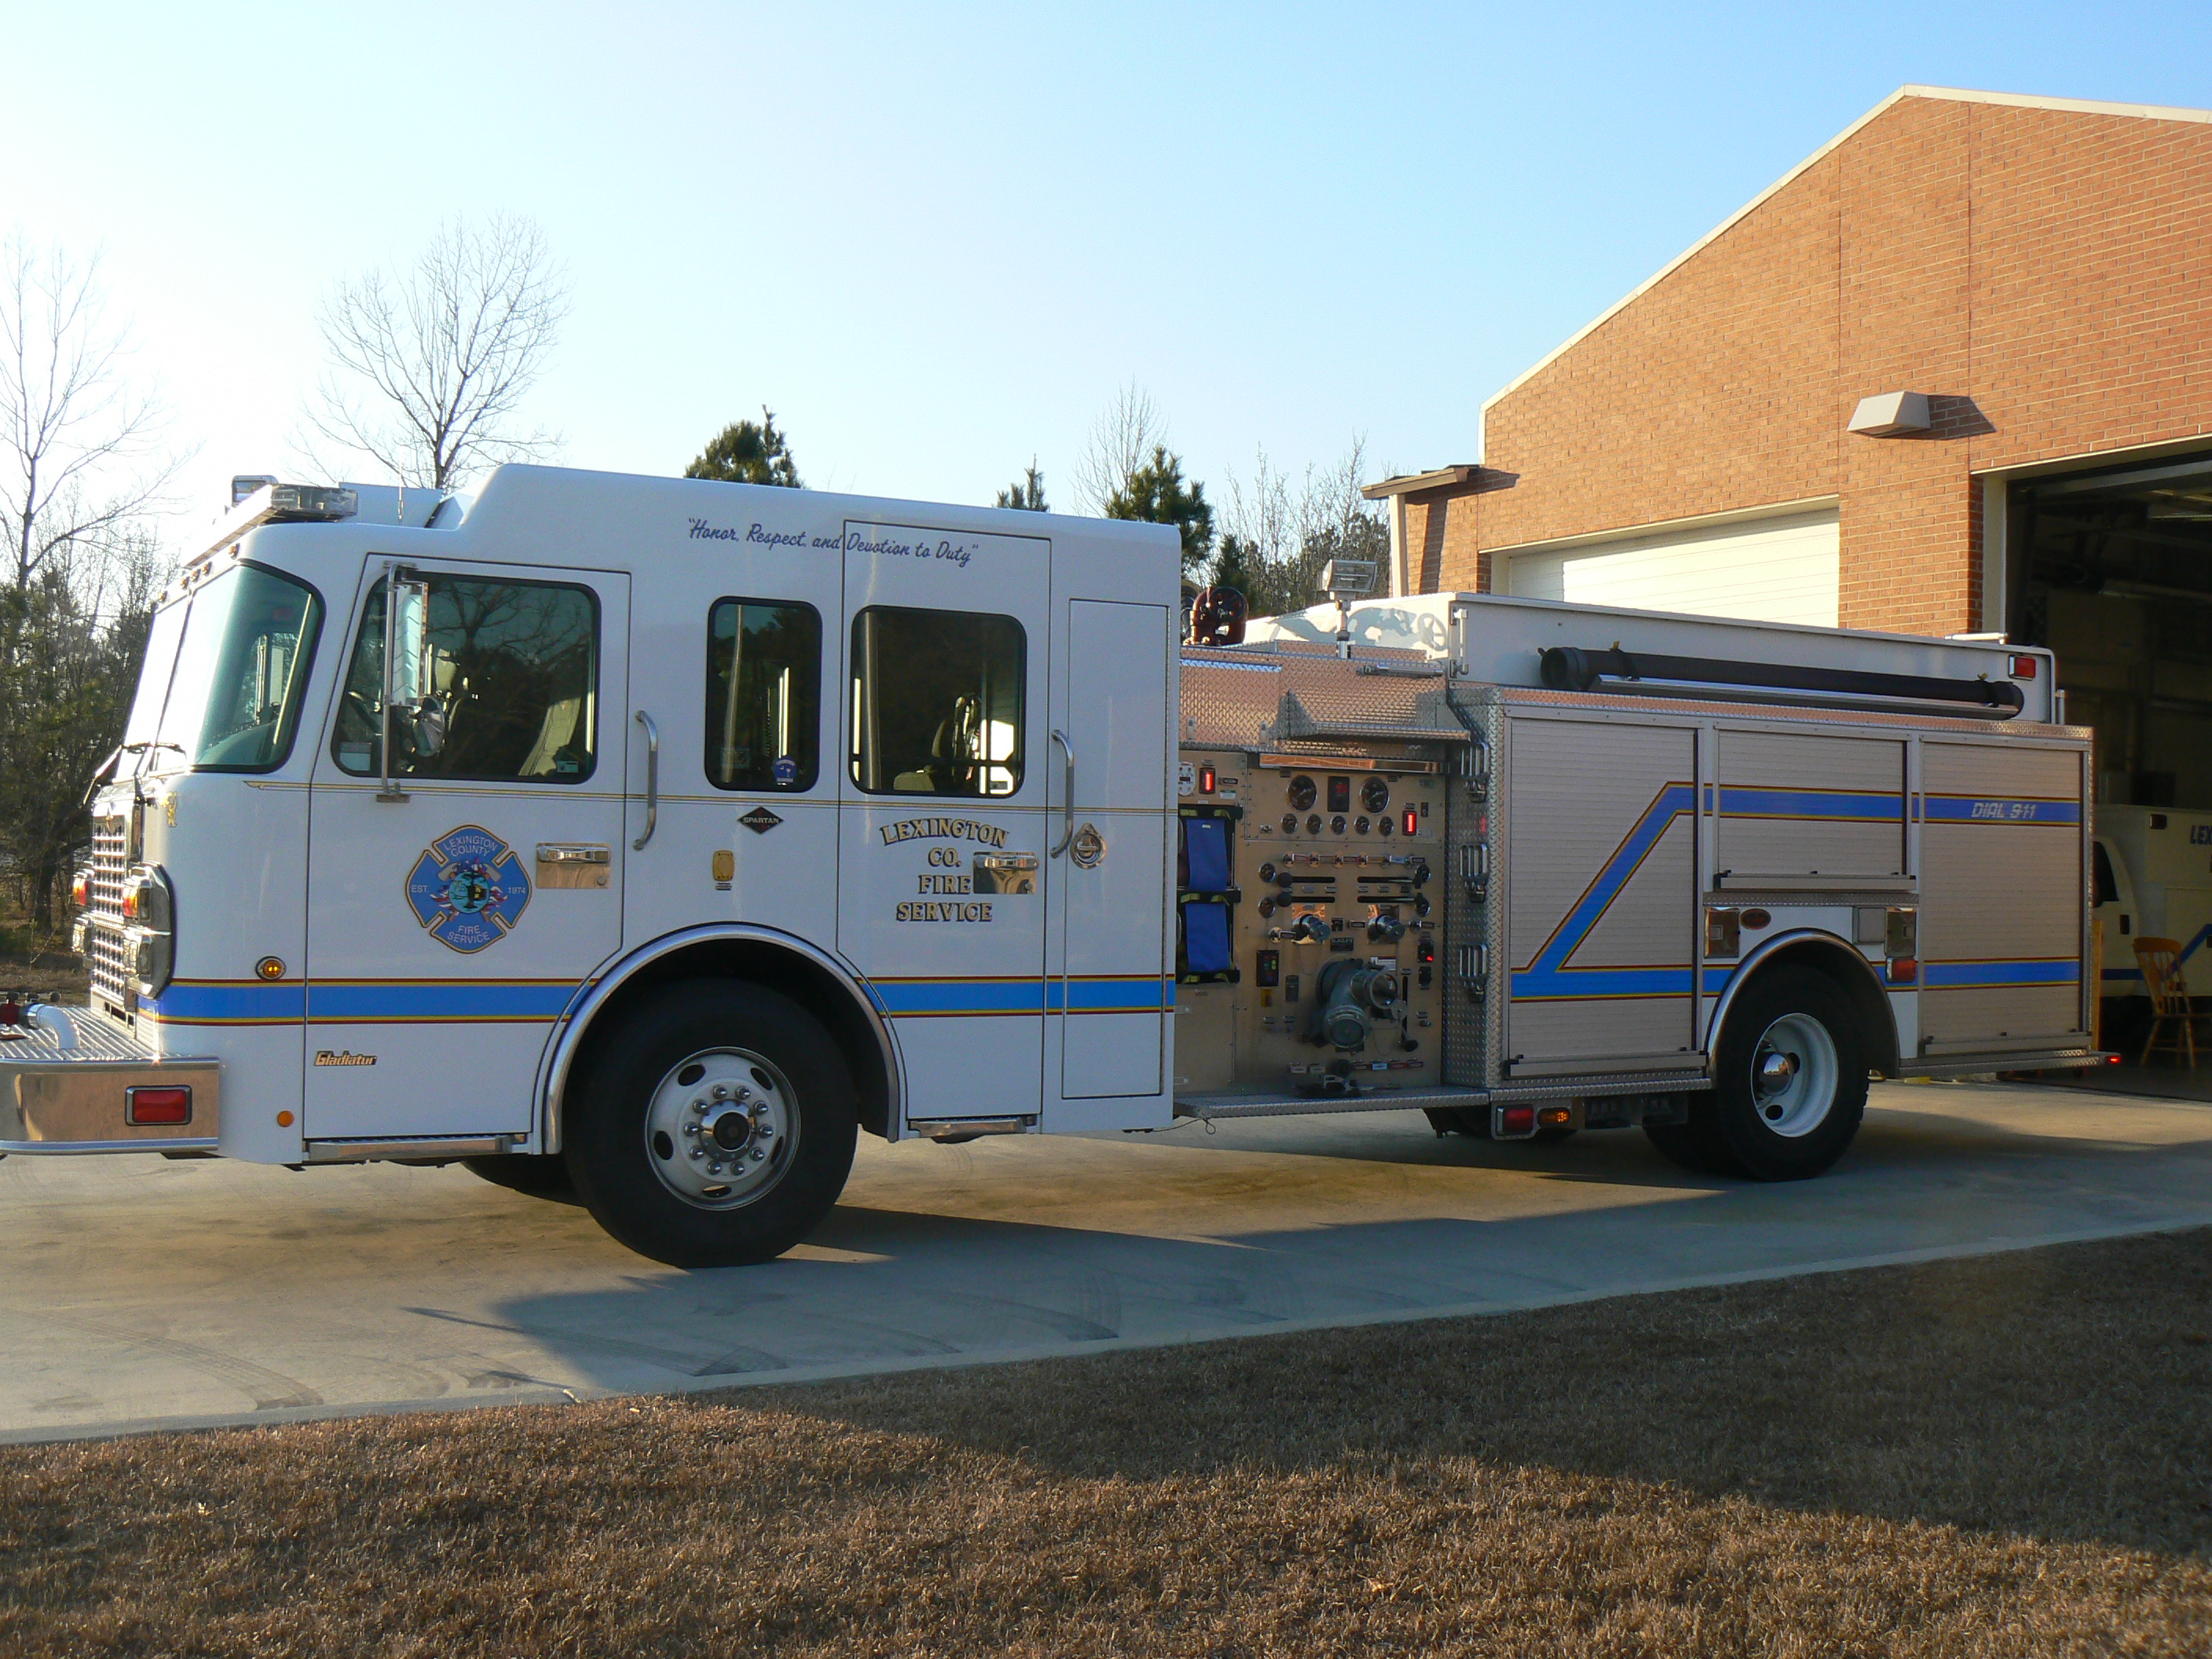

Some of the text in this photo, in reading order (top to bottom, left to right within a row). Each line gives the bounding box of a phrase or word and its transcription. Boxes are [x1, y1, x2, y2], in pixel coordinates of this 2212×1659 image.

[812, 535, 842, 549] and
[847, 533, 910, 556] Devotion
[915, 544, 930, 558] to
[936, 540, 979, 568] Duty"
[1971, 802, 2005, 819] DIAL
[879, 817, 1009, 848] LEXINGTON
[444, 835, 498, 851] LEXINGTON
[450, 846, 491, 857] COUNTY
[928, 847, 962, 868] CO.
[917, 874, 972, 894] FIRE
[896, 902, 994, 922] SERVICE
[447, 931, 491, 943] SERVICE
[458, 925, 481, 934] FIRE
[314, 1050, 377, 1066] Gladiator
